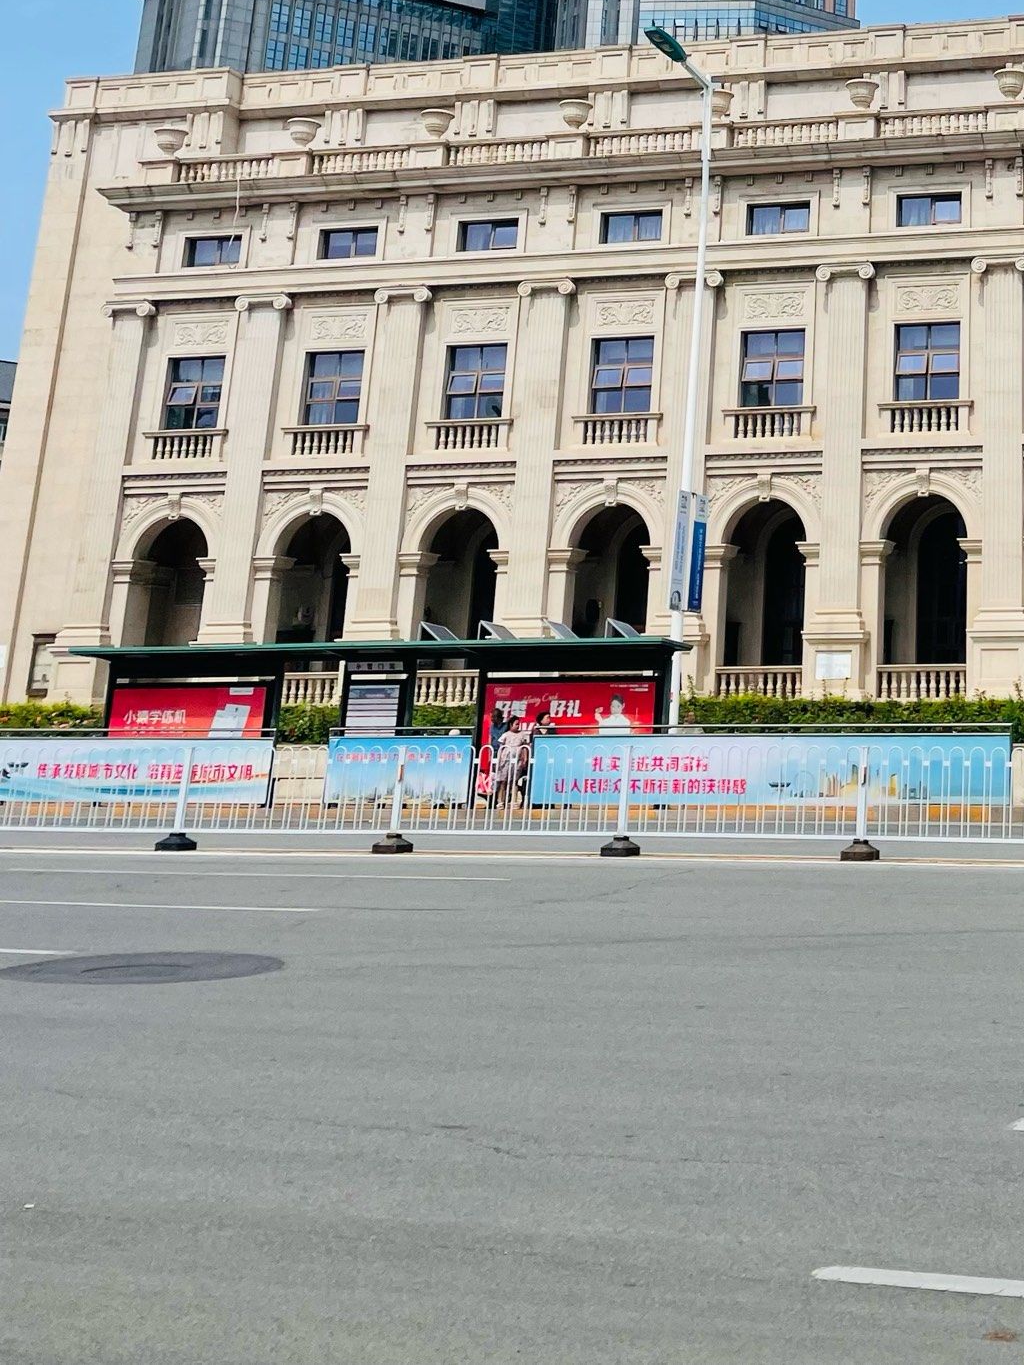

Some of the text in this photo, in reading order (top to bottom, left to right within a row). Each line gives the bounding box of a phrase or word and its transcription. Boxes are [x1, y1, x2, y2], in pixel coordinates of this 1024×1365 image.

[554, 778, 747, 795] 让人民群众不断有新的获得感
